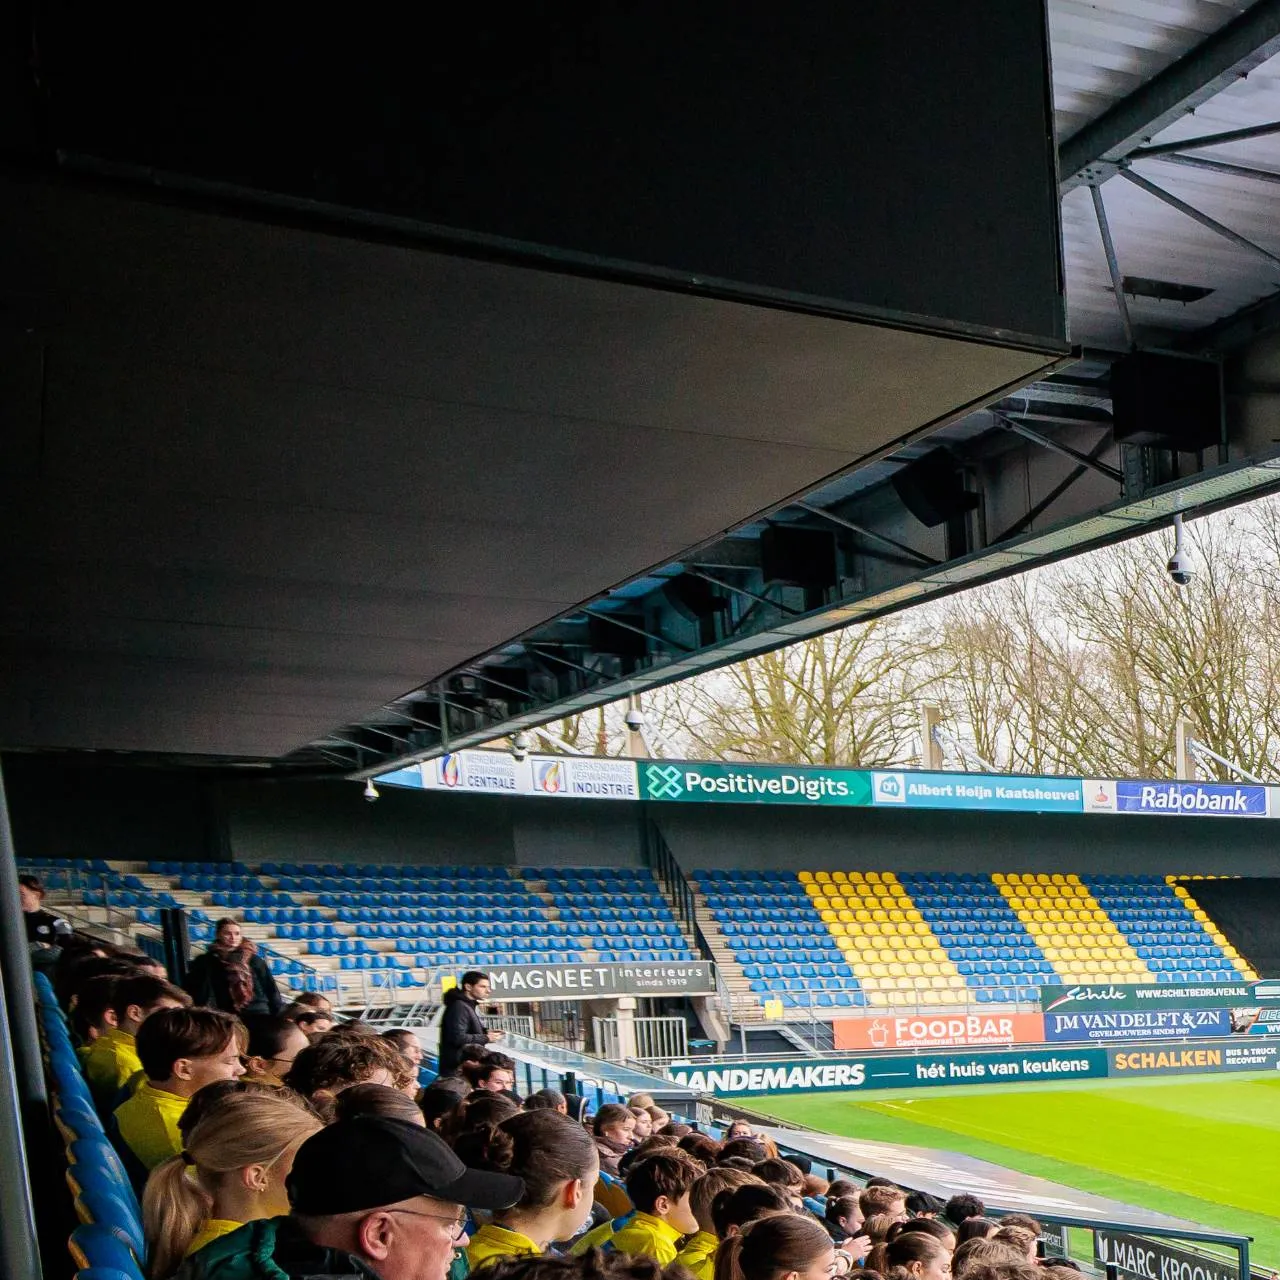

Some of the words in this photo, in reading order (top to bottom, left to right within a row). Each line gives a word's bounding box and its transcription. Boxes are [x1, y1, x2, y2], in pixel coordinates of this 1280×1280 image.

[467, 775, 516, 790] CENTRALE
[572, 781, 635, 796] INDUSTRIE
[685, 772, 855, 800] PositiveDigits.
[908, 783, 953, 798] Albert
[954, 785, 993, 801] Heijn
[995, 786, 1081, 802] Kaatsheuvel
[1141, 785, 1248, 812] Rabobank
[490, 967, 609, 990] MAGNEET
[618, 967, 704, 979] interieurs
[635, 978, 664, 988] sinds
[1054, 1014, 1079, 1034] JM
[1081, 1013, 1119, 1029] VAN
[1119, 1011, 1181, 1028] DELFT
[1182, 1013, 1197, 1029] &
[1196, 1010, 1222, 1025] ZN
[1088, 1028, 1152, 1039] GEVELBOUWERS
[1114, 1049, 1222, 1071] SCHALKEN
[1225, 1047, 1243, 1057] BUS
[1250, 1046, 1277, 1056] TRUCK
[1225, 1055, 1267, 1065] RECOVERY
[668, 1063, 866, 1093] MANDEMAKERS
[915, 1063, 947, 1079] hét
[948, 1061, 986, 1078] huis
[987, 1062, 1019, 1076] van
[1021, 1057, 1090, 1074] keukens
[1113, 1239, 1156, 1280] MARC
